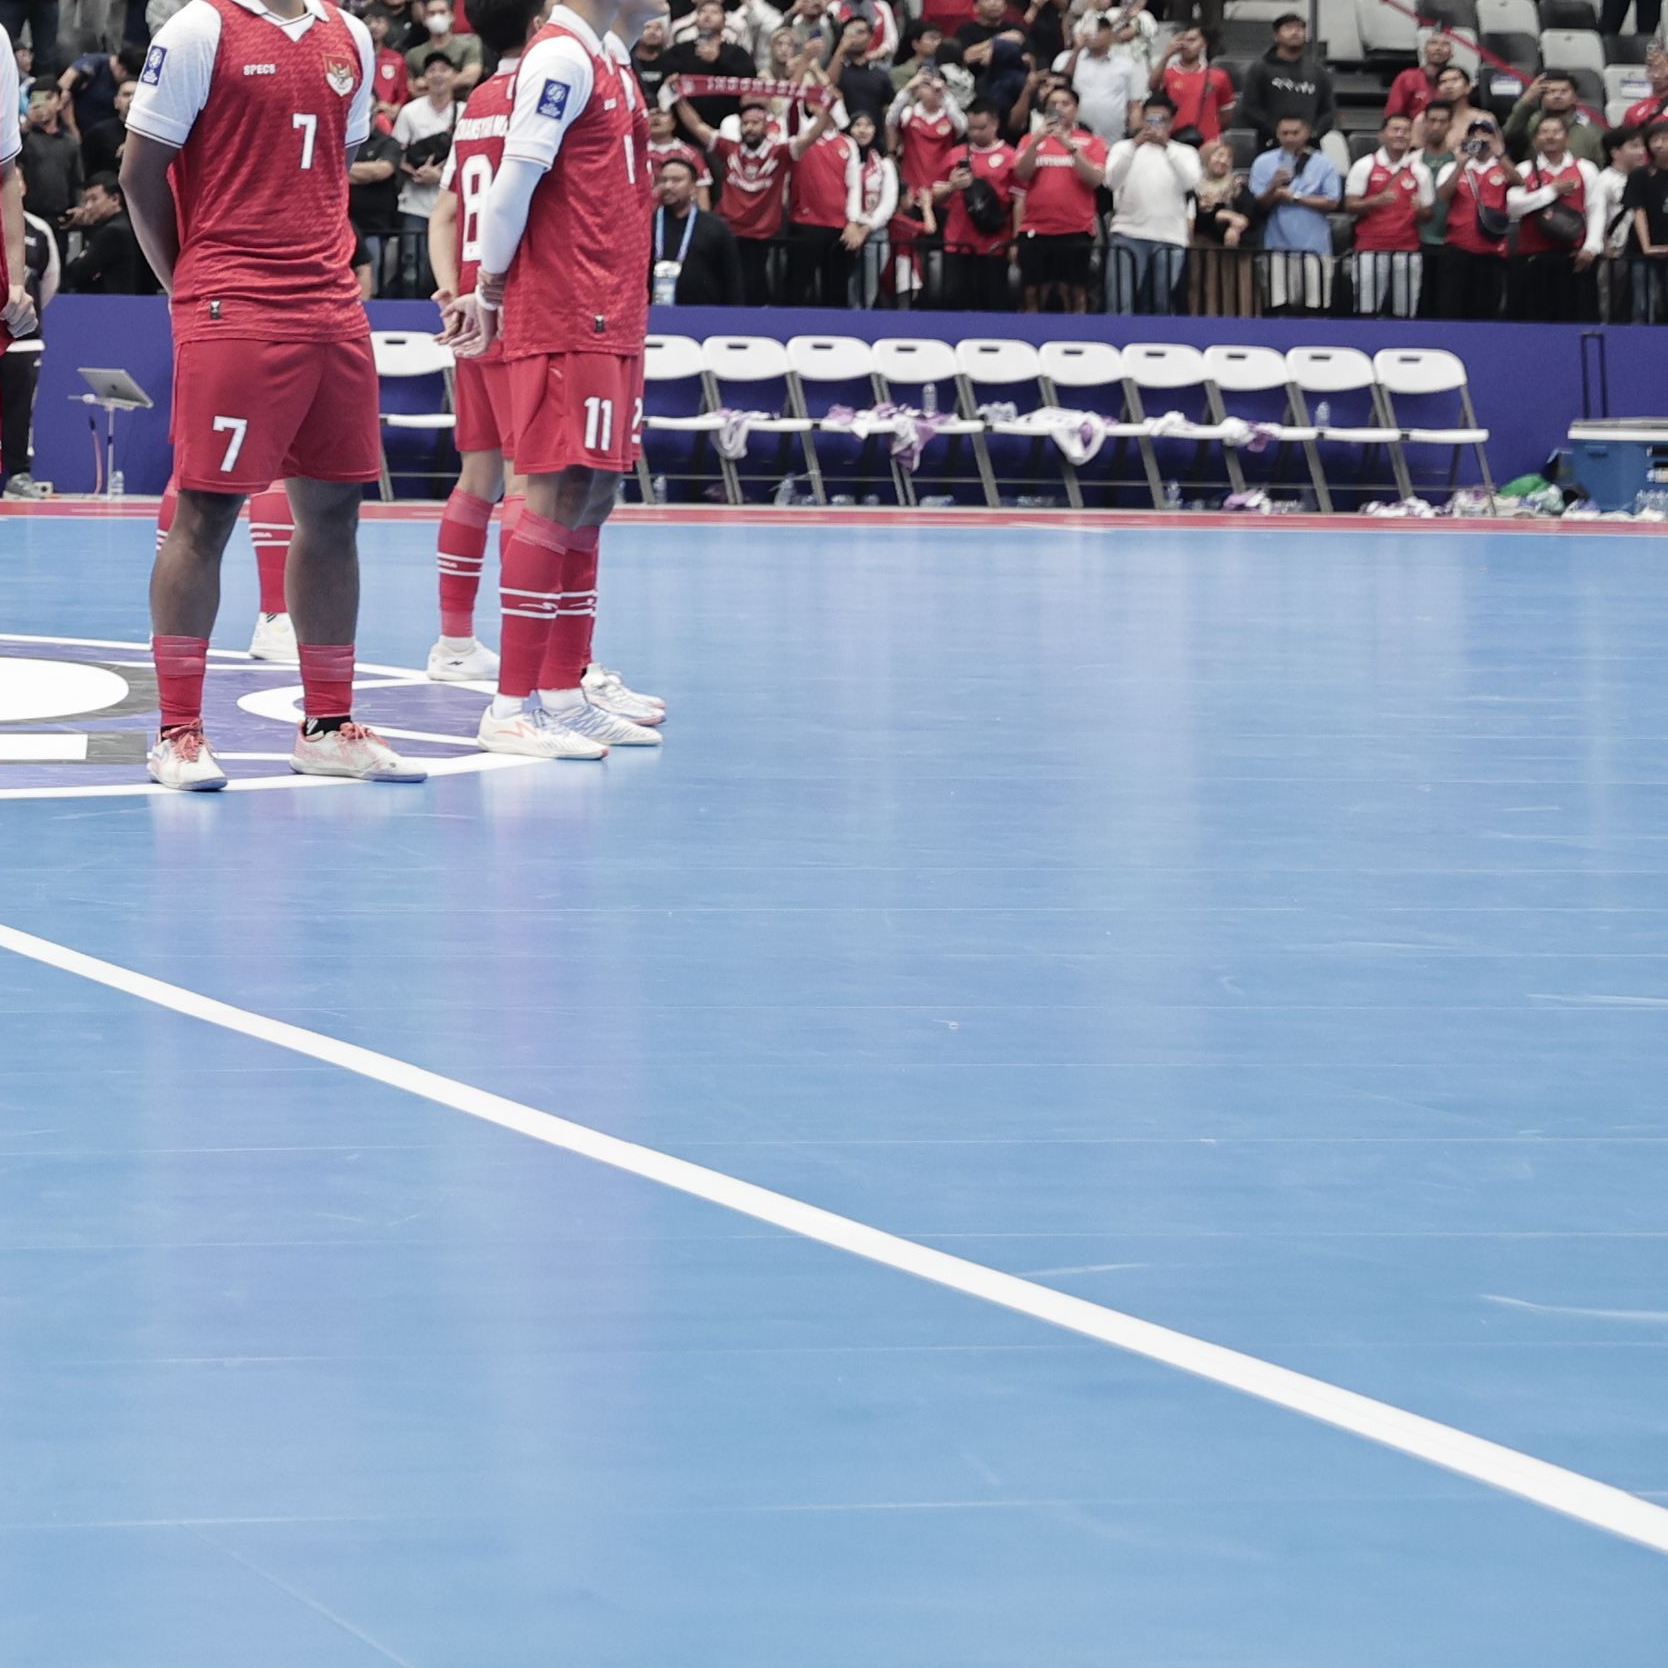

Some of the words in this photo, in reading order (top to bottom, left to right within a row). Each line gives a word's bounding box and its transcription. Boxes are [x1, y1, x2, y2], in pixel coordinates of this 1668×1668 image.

[243, 64, 276, 76] SPECS
[292, 113, 317, 169] 7
[462, 154, 494, 261] 8
[213, 416, 247, 472] 7
[584, 396, 612, 451] 11
